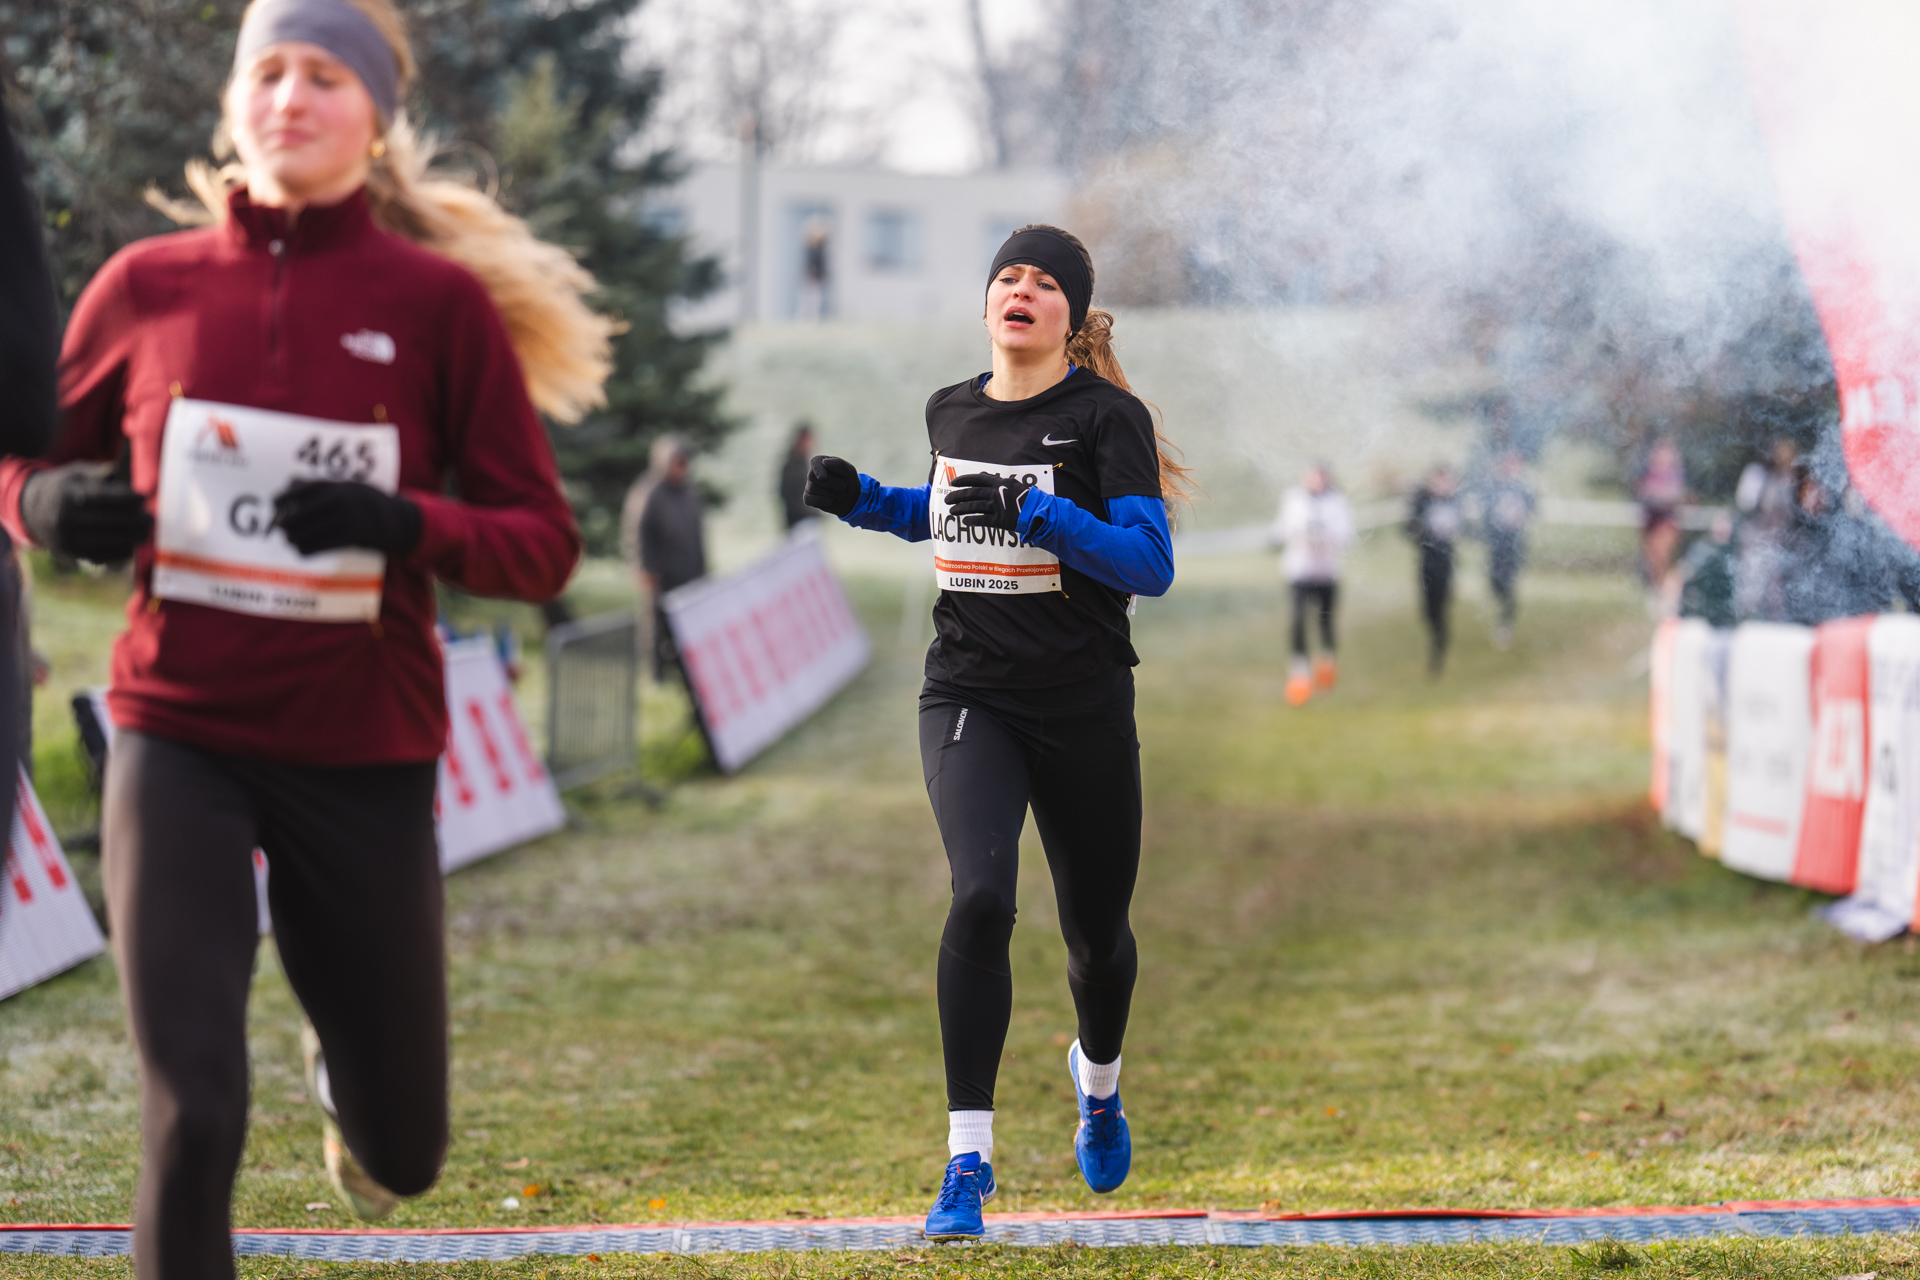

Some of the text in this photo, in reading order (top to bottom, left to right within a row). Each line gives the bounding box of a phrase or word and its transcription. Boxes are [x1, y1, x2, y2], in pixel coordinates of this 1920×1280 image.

[295, 434, 376, 483] 465
[994, 566, 1016, 574] Biegach
[949, 577, 1019, 590] LUBIN 2025
[953, 708, 968, 740] SALOMON
